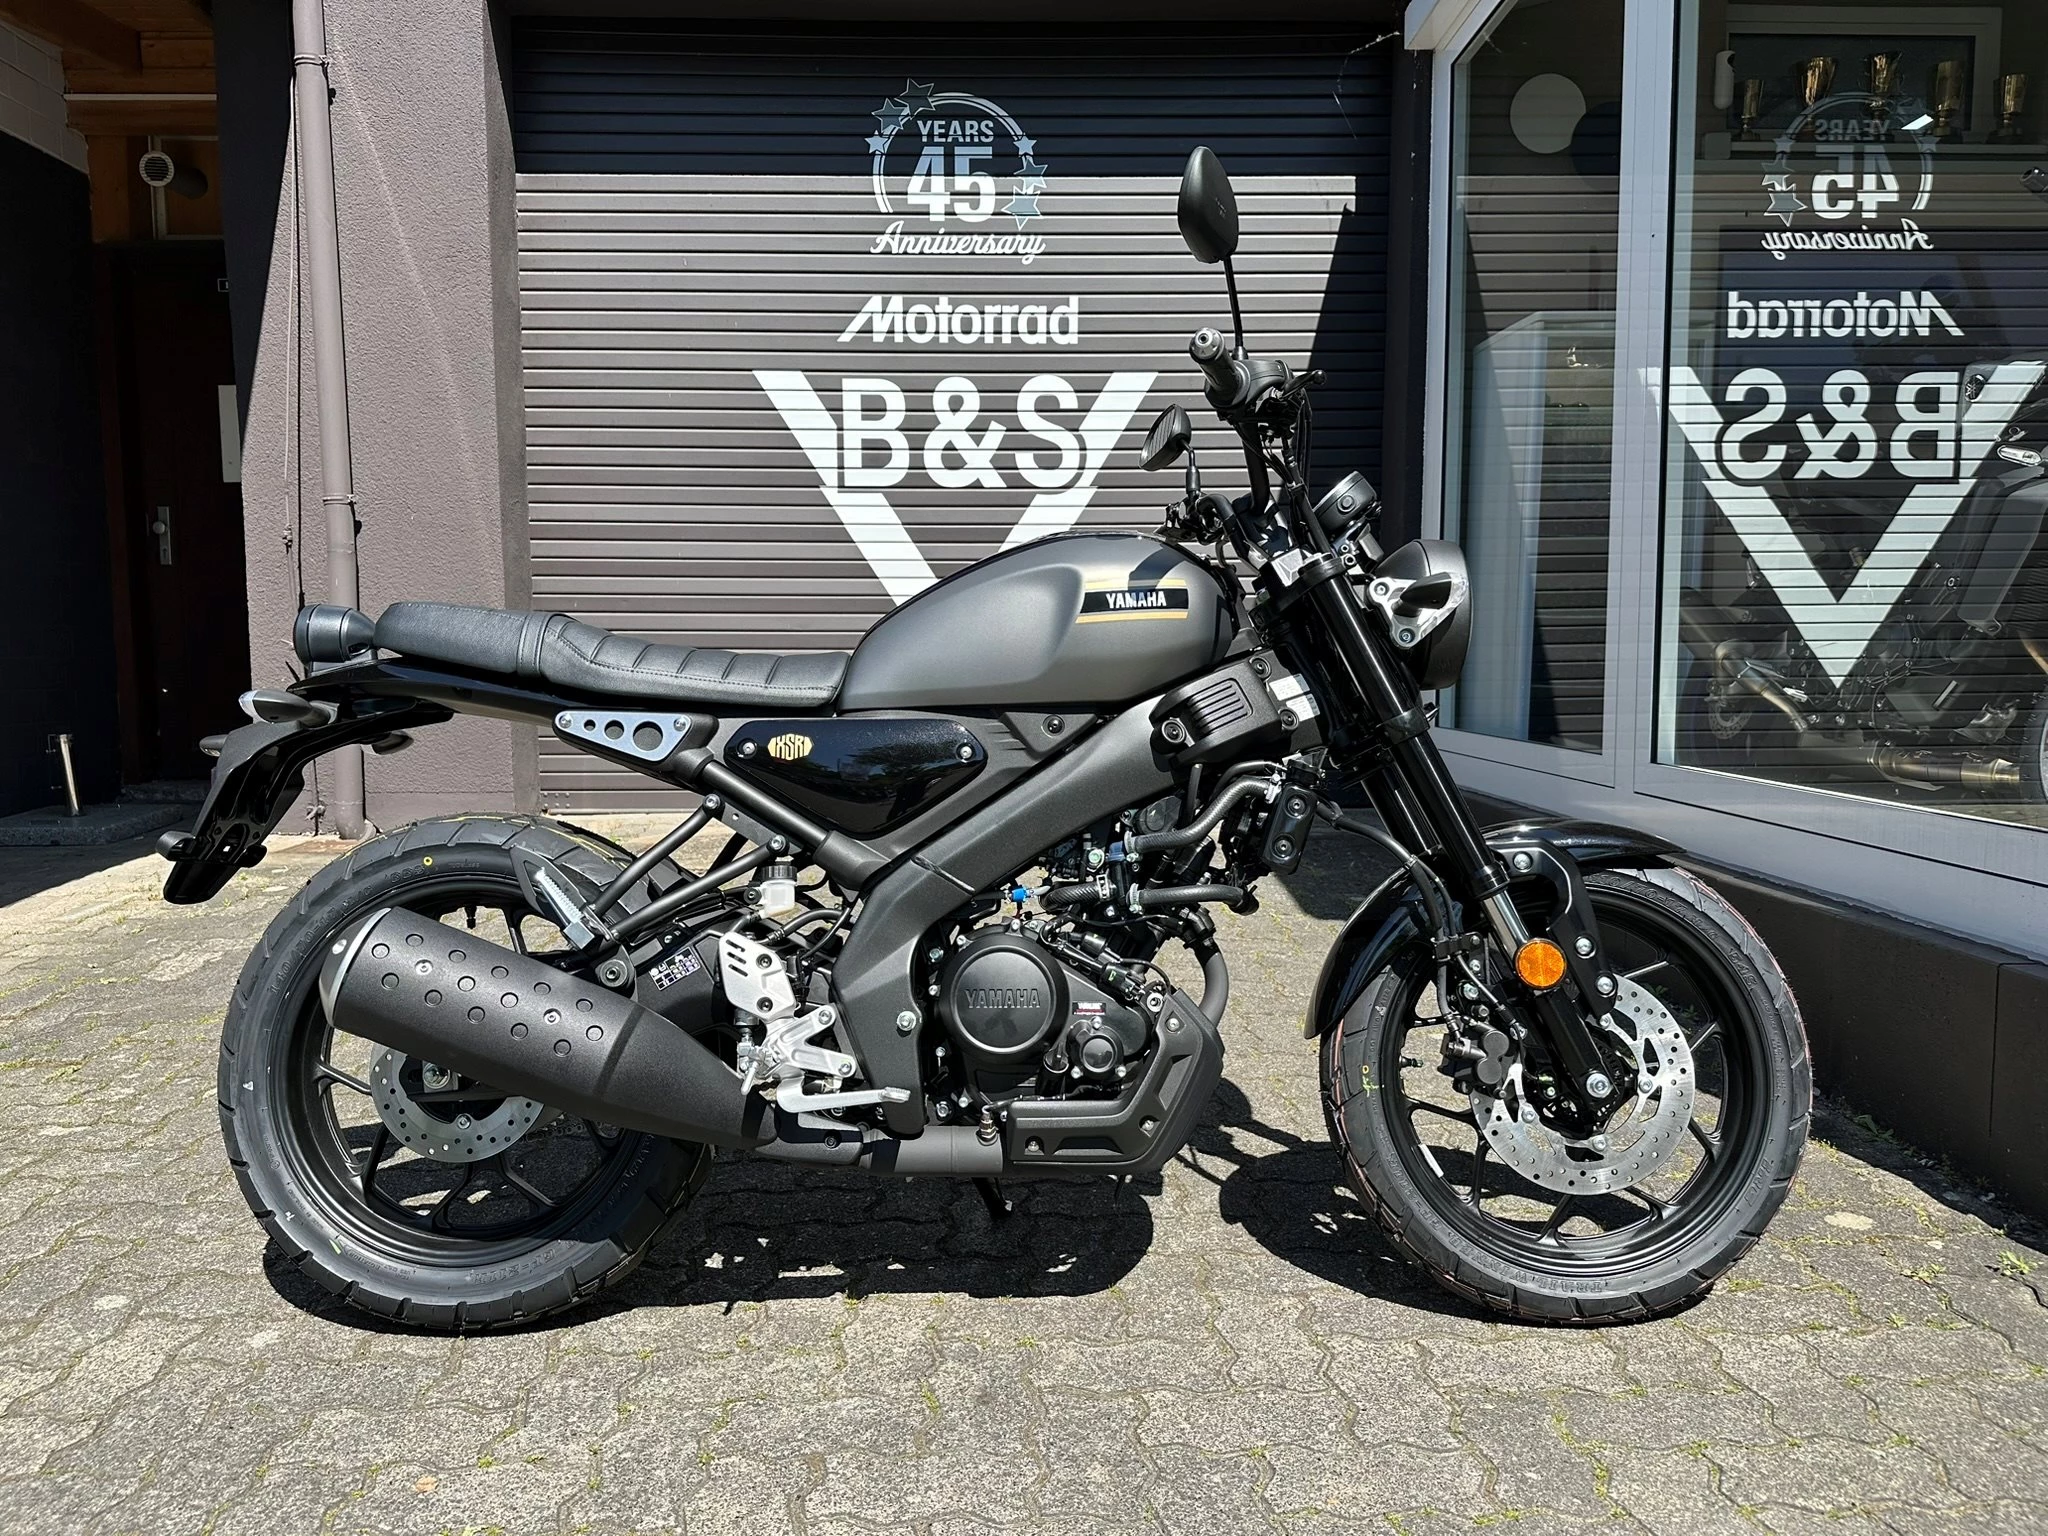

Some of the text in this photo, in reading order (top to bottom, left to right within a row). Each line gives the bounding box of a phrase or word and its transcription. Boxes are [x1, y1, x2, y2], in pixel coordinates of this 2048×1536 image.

[917, 119, 995, 142] YEARS
[906, 146, 997, 222] 45
[869, 220, 1047, 265] Anniversary
[837, 295, 1080, 345] Motorrad
[841, 374, 1083, 489] B&S
[1105, 590, 1167, 609] YAMAHA
[774, 733, 807, 760] XSR
[965, 988, 1041, 1009] YAMAHA
